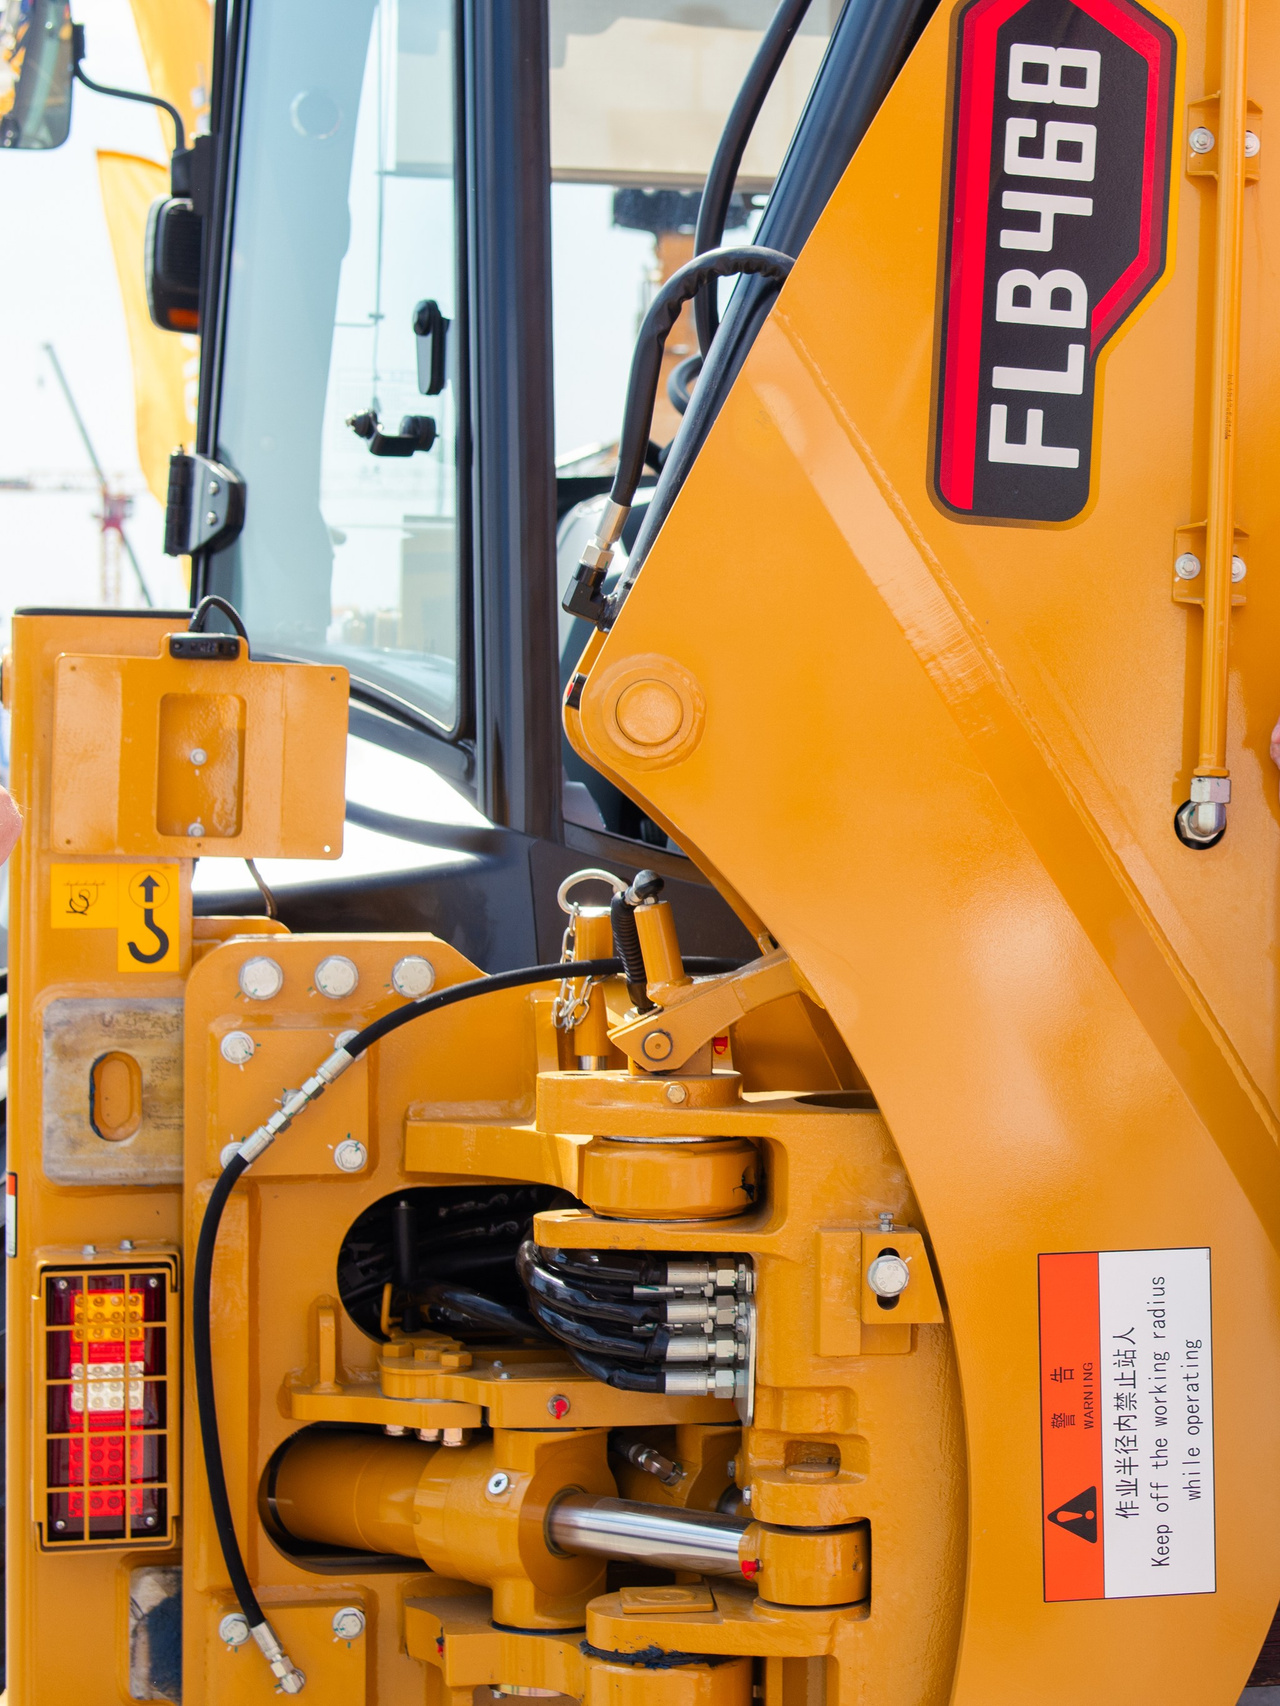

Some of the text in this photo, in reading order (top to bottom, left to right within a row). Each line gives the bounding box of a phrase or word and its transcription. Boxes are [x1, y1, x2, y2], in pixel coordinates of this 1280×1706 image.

[988, 43, 1101, 469] FLB468
[1083, 1362, 1094, 1430] WARNING
[1112, 1326, 1140, 1519] 作业半径内禁止站人
[1147, 1276, 1173, 1567] Keep off the working radius
[1180, 1339, 1204, 1501] while operating
